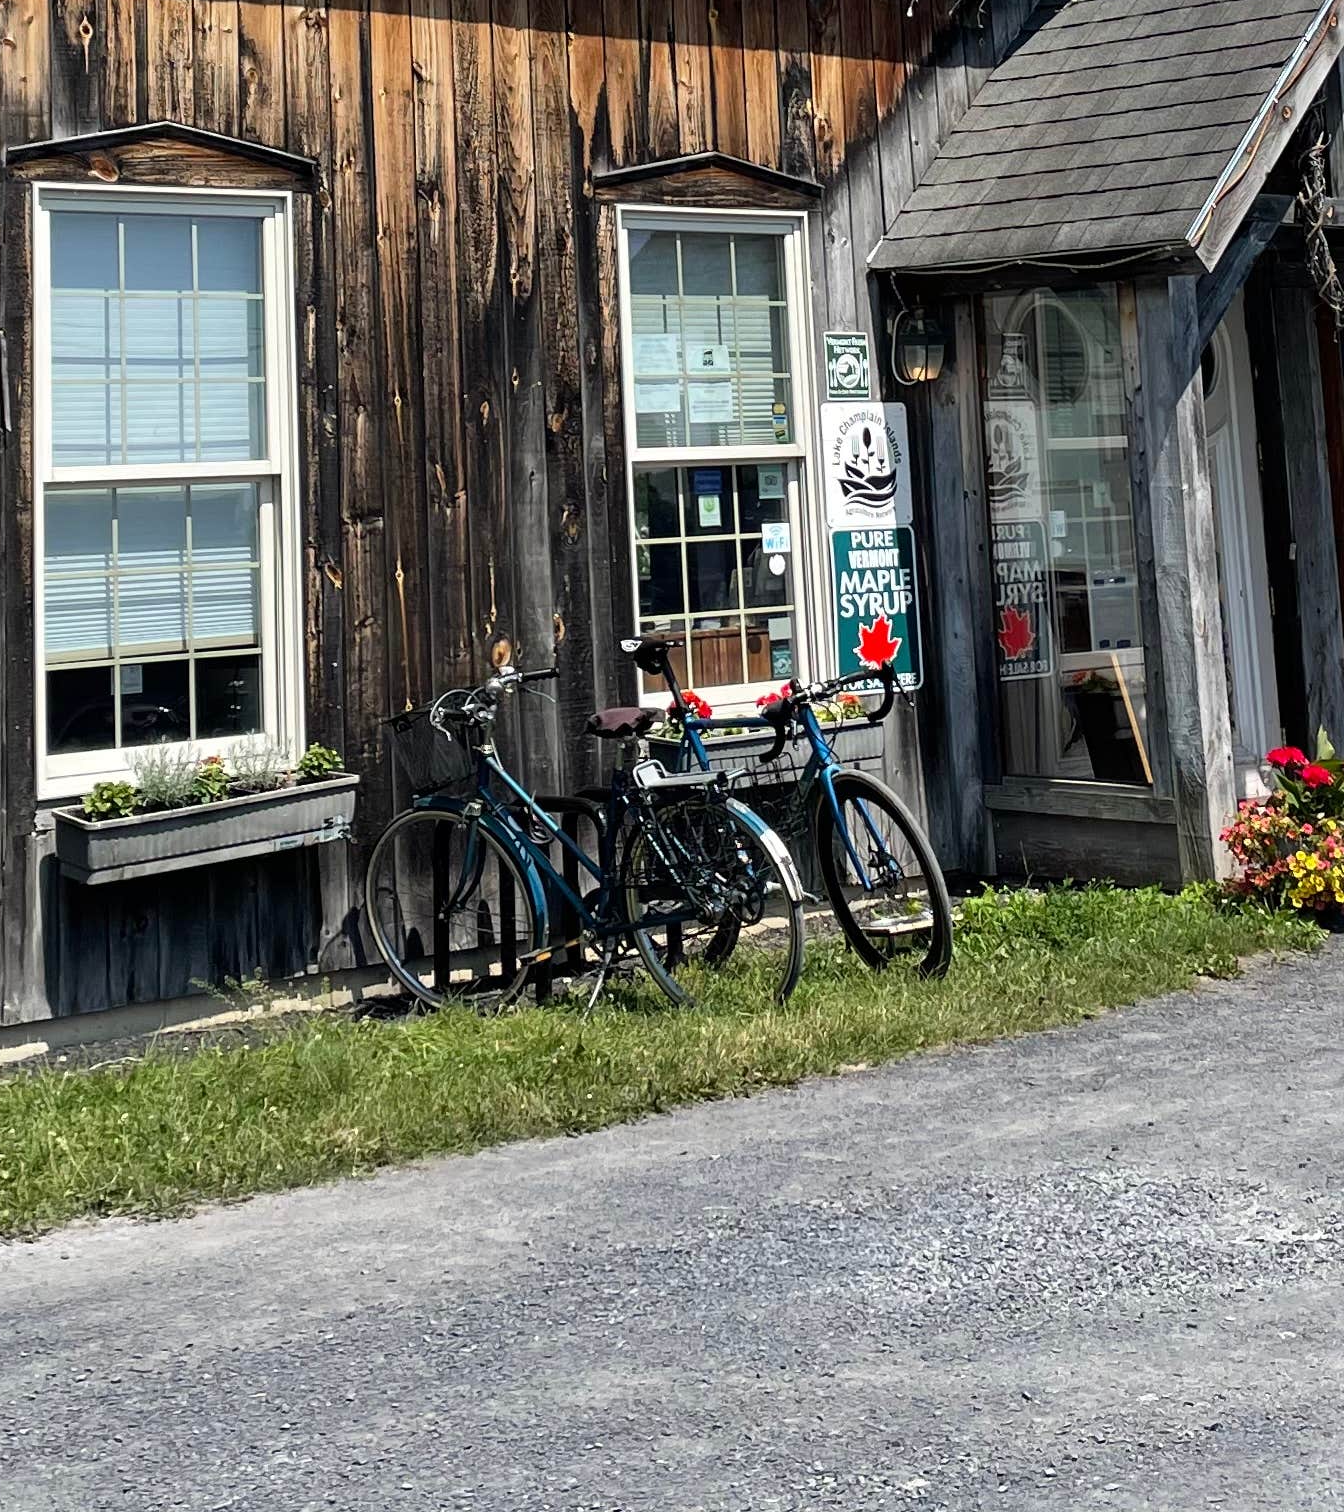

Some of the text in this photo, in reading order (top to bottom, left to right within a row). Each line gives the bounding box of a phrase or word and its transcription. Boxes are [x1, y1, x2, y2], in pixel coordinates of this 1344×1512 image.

[832, 437, 844, 466] Lake
[839, 410, 883, 436] Champlain
[850, 530, 894, 549] PURE
[848, 548, 900, 570] VERMONT
[840, 569, 912, 595] MAPLE
[840, 591, 913, 618] SYRUP
